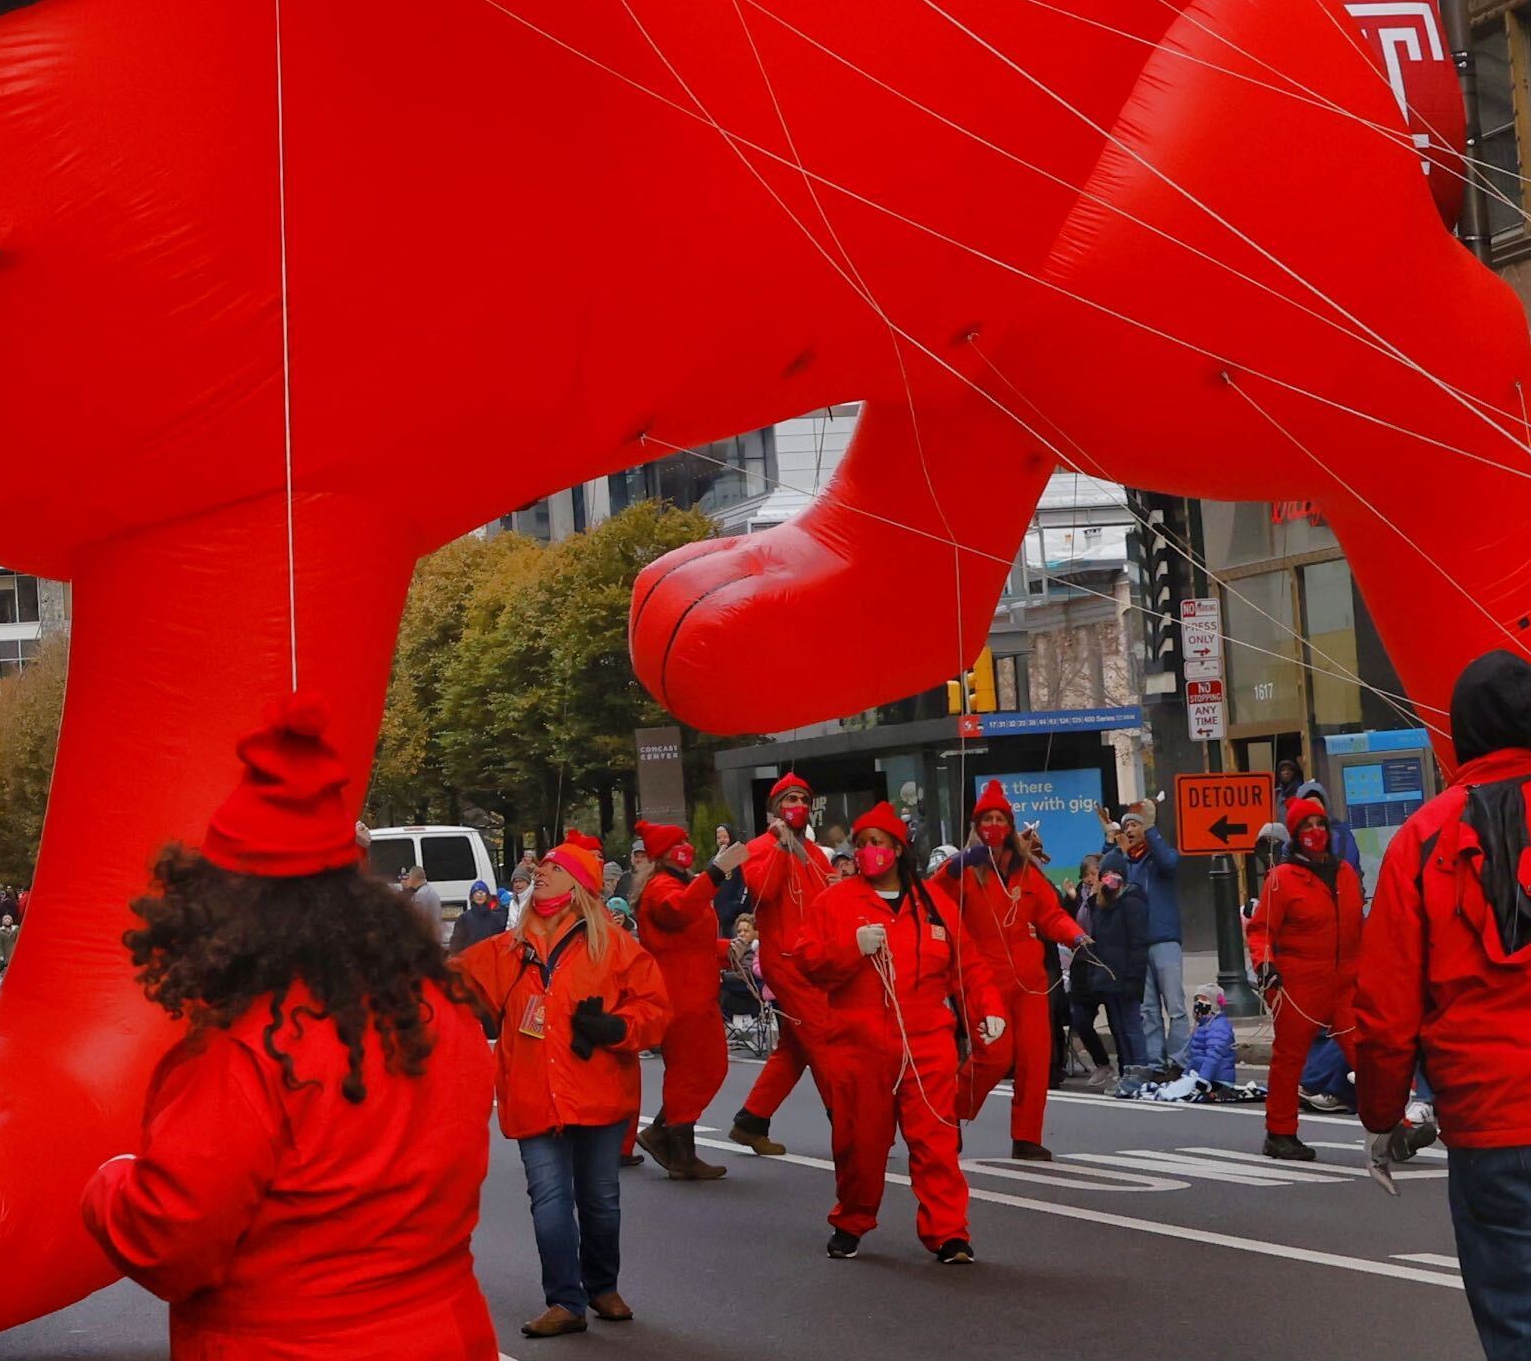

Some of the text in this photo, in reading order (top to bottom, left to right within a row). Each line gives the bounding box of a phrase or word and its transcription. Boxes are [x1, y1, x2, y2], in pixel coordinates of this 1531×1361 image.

[1183, 602, 1195, 616] NO
[1184, 621, 1218, 632] PRESS
[1188, 635, 1215, 645] ONLY
[1198, 682, 1211, 694] NO
[1254, 682, 1274, 700] 1617
[1195, 705, 1216, 716] ANY
[1195, 716, 1218, 726] TIME
[640, 745, 678, 753] COMCAST
[640, 752, 678, 760] CENTER
[1013, 781, 1052, 795] there
[1189, 785, 1263, 808] DETOUR
[1031, 796, 1065, 812] with
